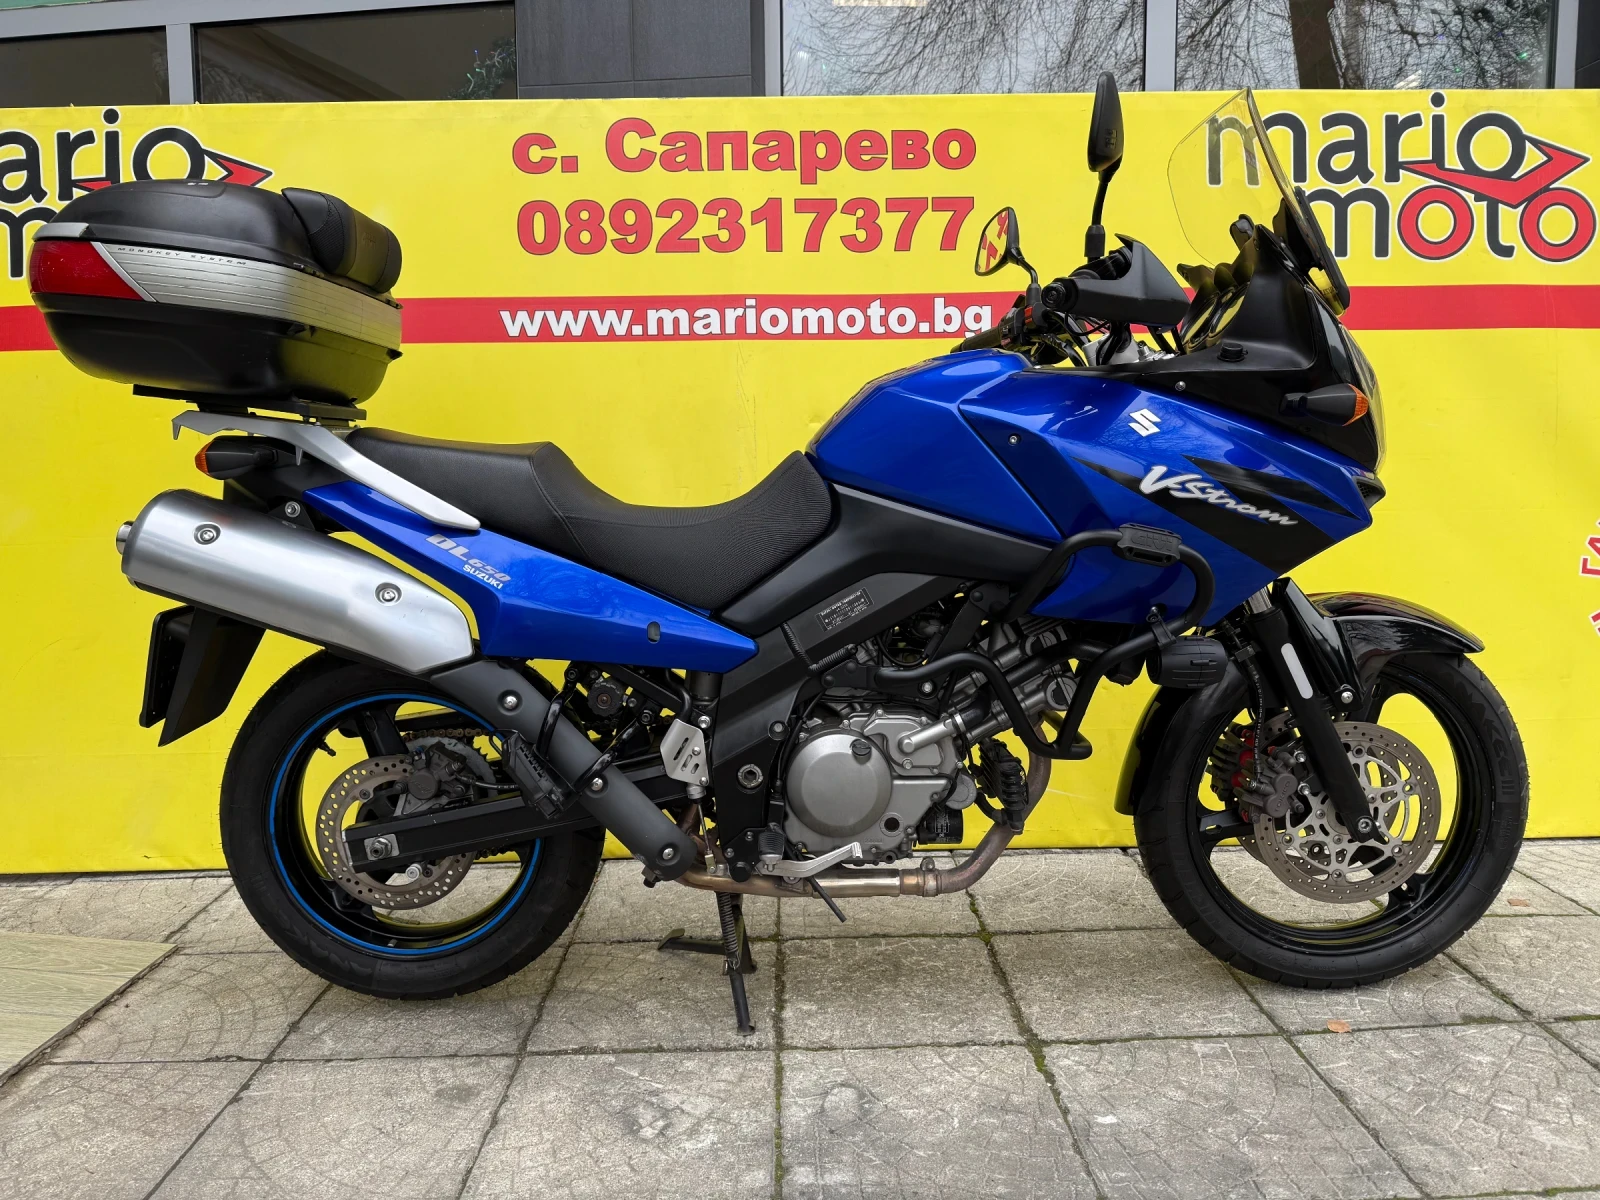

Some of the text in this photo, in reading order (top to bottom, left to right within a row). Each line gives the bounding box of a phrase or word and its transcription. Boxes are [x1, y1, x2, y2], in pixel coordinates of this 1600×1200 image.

[512, 117, 977, 185] с. Сапарево
[1206, 91, 1526, 186] mario
[516, 196, 975, 256] 0892317377
[1295, 185, 1597, 262] moto
[117, 247, 247, 266] MONOKEY SYSTEM
[499, 297, 994, 338] www.mariomoto.bg
[462, 564, 504, 589] SUZUKI
